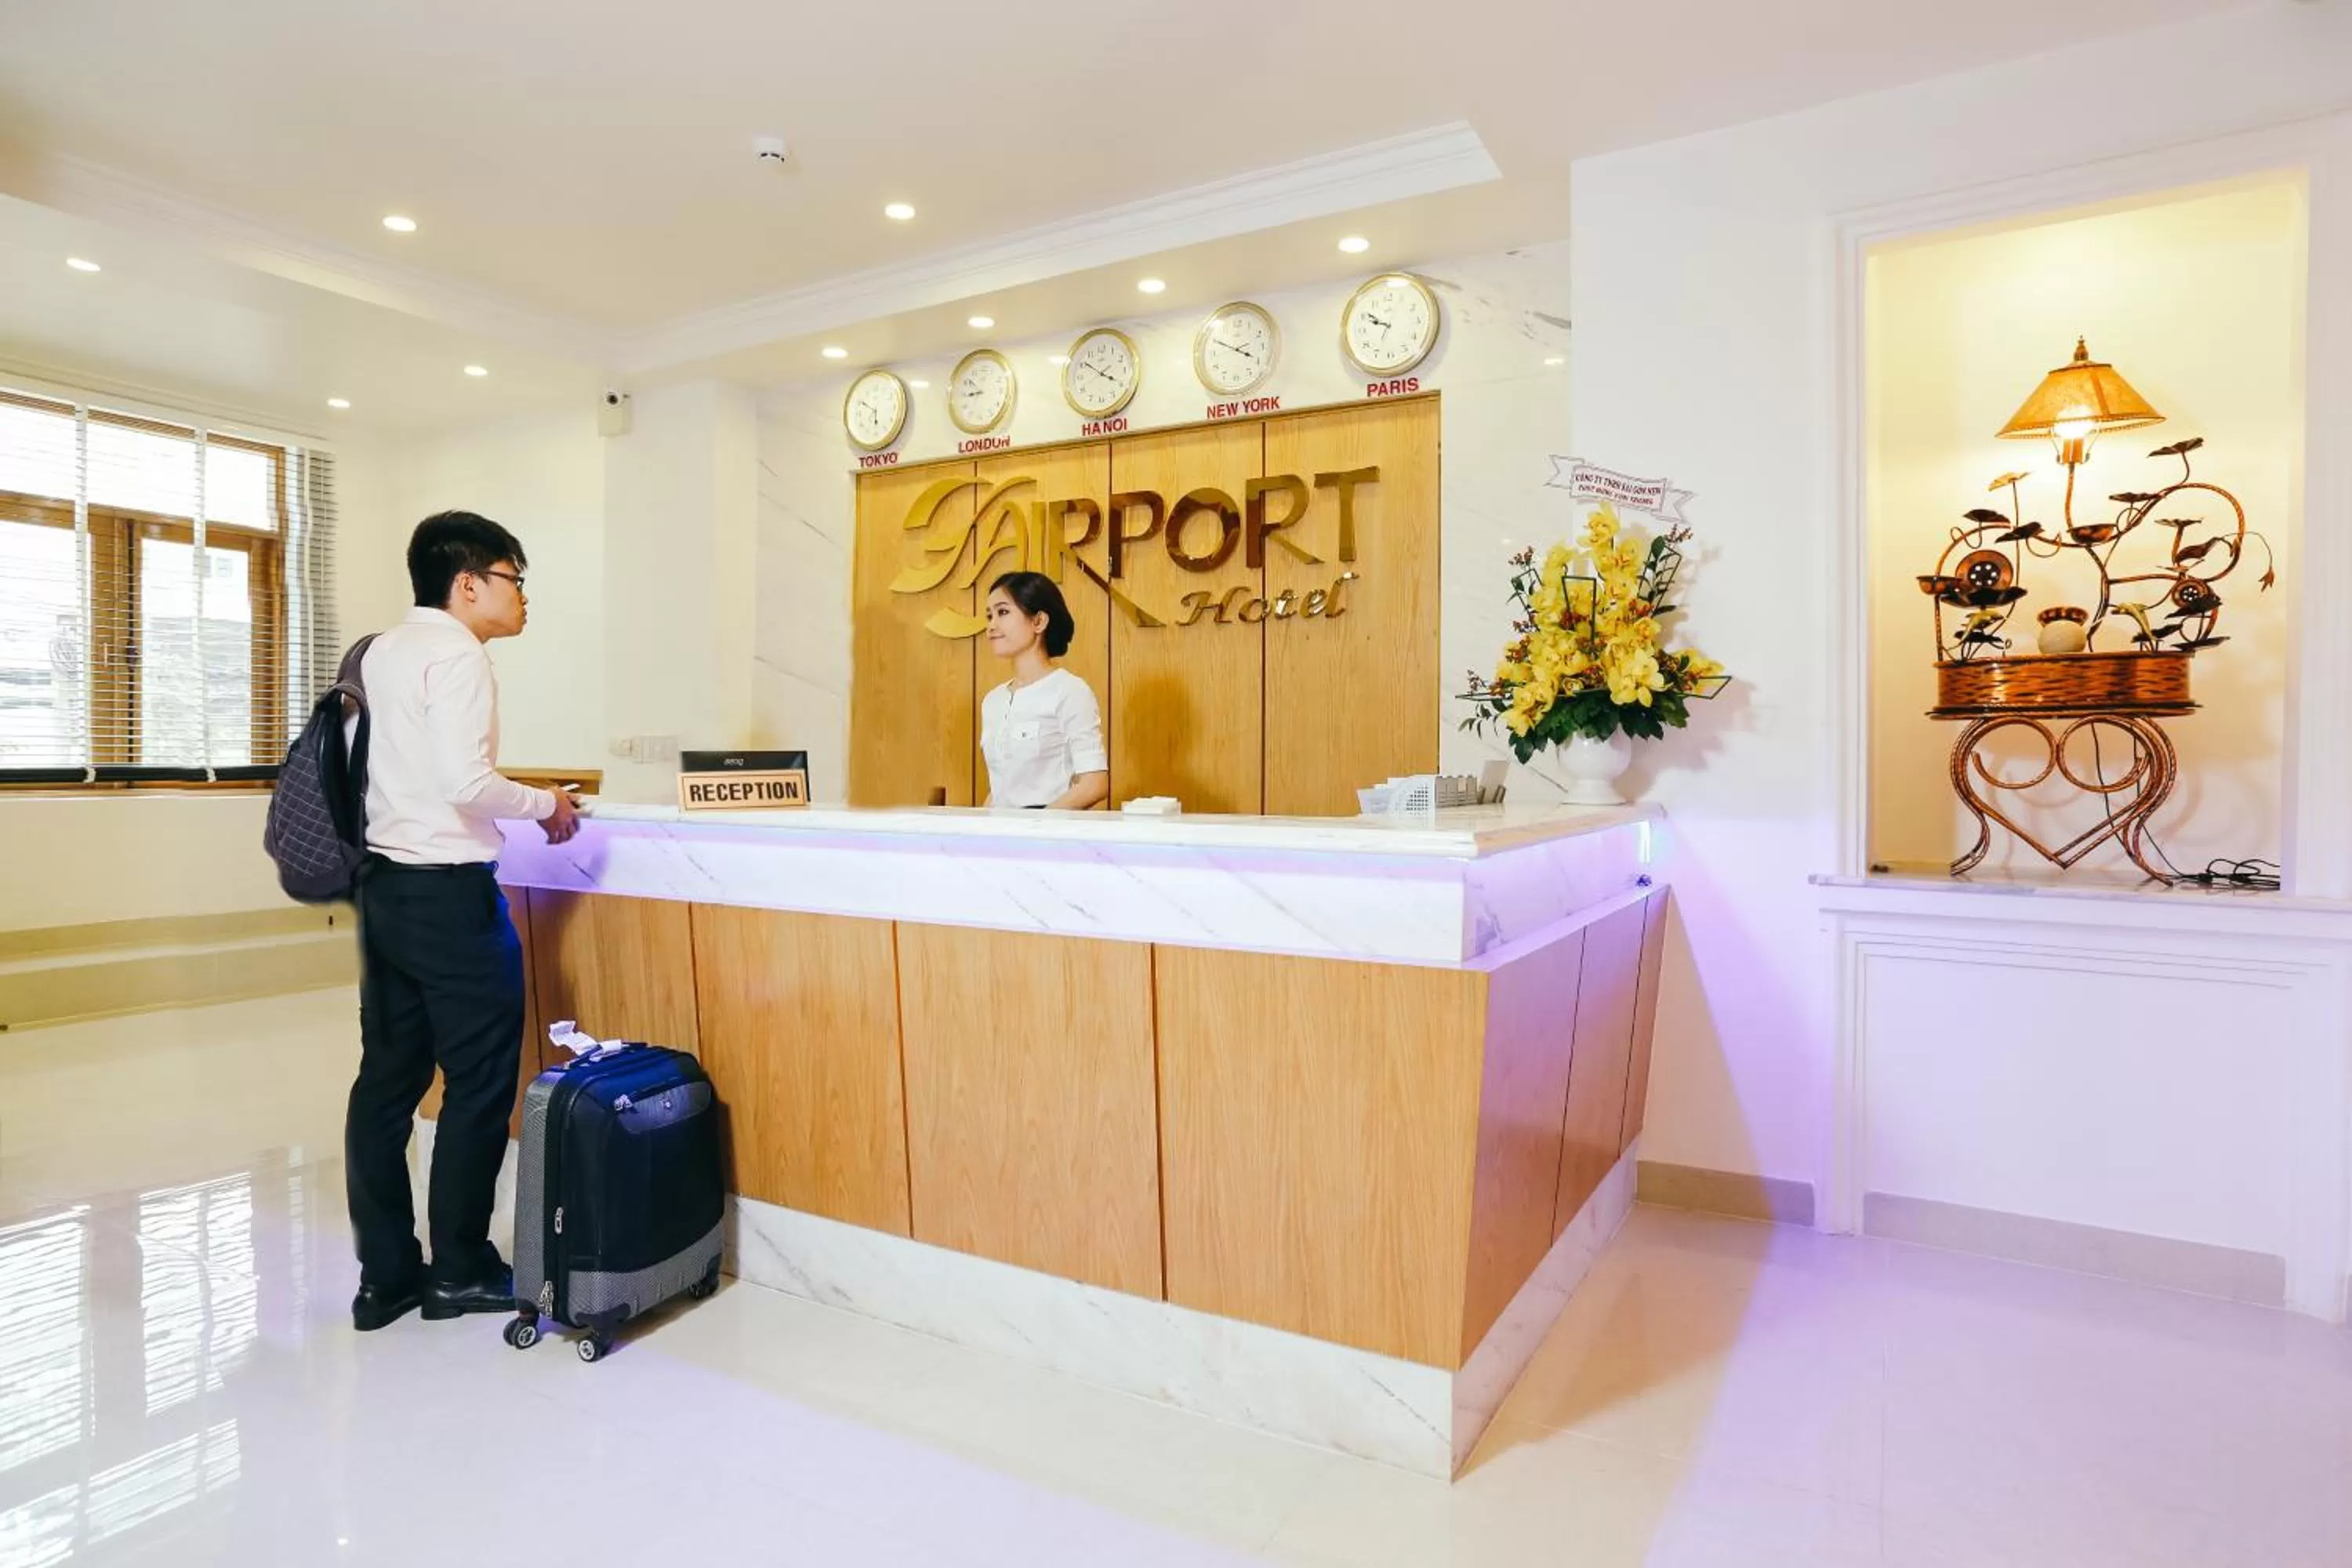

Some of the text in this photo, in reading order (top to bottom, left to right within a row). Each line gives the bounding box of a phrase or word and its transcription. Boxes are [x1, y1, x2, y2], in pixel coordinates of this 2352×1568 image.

[1367, 377, 1419, 397] PARIS
[1207, 396, 1280, 418] NEW YORK
[858, 452, 898, 468] TOKYO
[958, 466, 1380, 627] AIRPORT
[1175, 571, 1360, 626] Hotel
[689, 781, 799, 802] RECEPTION
